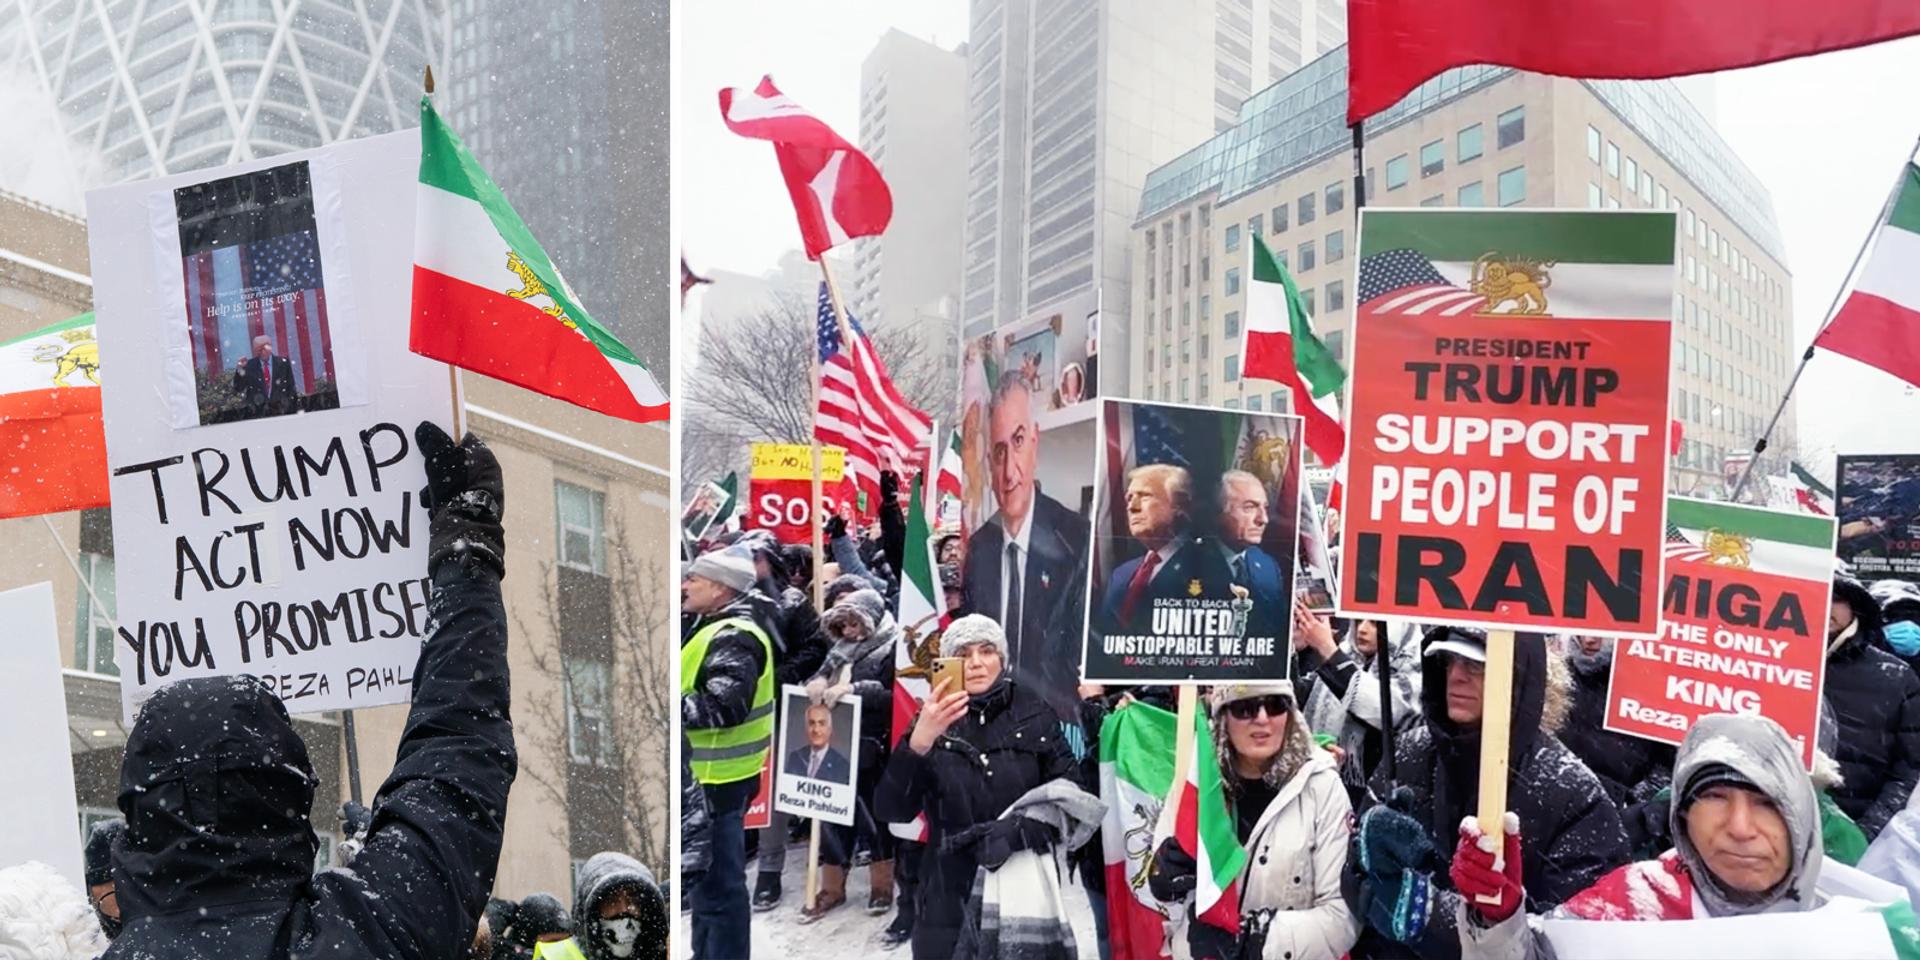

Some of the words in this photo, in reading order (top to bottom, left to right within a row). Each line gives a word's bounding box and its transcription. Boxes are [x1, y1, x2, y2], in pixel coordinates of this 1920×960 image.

[207, 303, 230, 317] Help
[233, 303, 242, 312] is
[245, 300, 258, 309] on
[262, 296, 274, 307] its
[1435, 337, 1591, 361] PRESIDENT
[1404, 361, 1620, 408] TRUMP
[1373, 413, 1649, 464] SUPPORT
[113, 422, 409, 524] TRUMP
[1370, 465, 1557, 531] PEOPLE
[1572, 475, 1639, 535] OF
[174, 522, 264, 600] ACT
[288, 491, 411, 571] NOW
[1354, 532, 1643, 624] IRAN
[1154, 598, 1182, 607] BACK
[1185, 599, 1199, 607] TO
[1202, 599, 1230, 609] BACK
[118, 618, 216, 686] YOU
[234, 577, 433, 664] PROMISE
[1152, 608, 1233, 636] UNITED
[1662, 620, 1708, 645] THE
[1713, 628, 1790, 659] ONLY
[1103, 635, 1214, 656] UNSTOPPABLE
[1219, 637, 1242, 656] WE
[1245, 637, 1275, 656] ARE
[1124, 656, 1158, 666] MAKE
[1220, 657, 1254, 667] AGAIN
[346, 665, 412, 699] PAHL
[1627, 640, 1813, 690] ALTERNATIVE
[1619, 697, 1689, 731] Reza
[1665, 675, 1761, 717] KING
[779, 793, 805, 807] Reza
[808, 799, 849, 816] Pahlavi
[796, 780, 832, 798] KING
